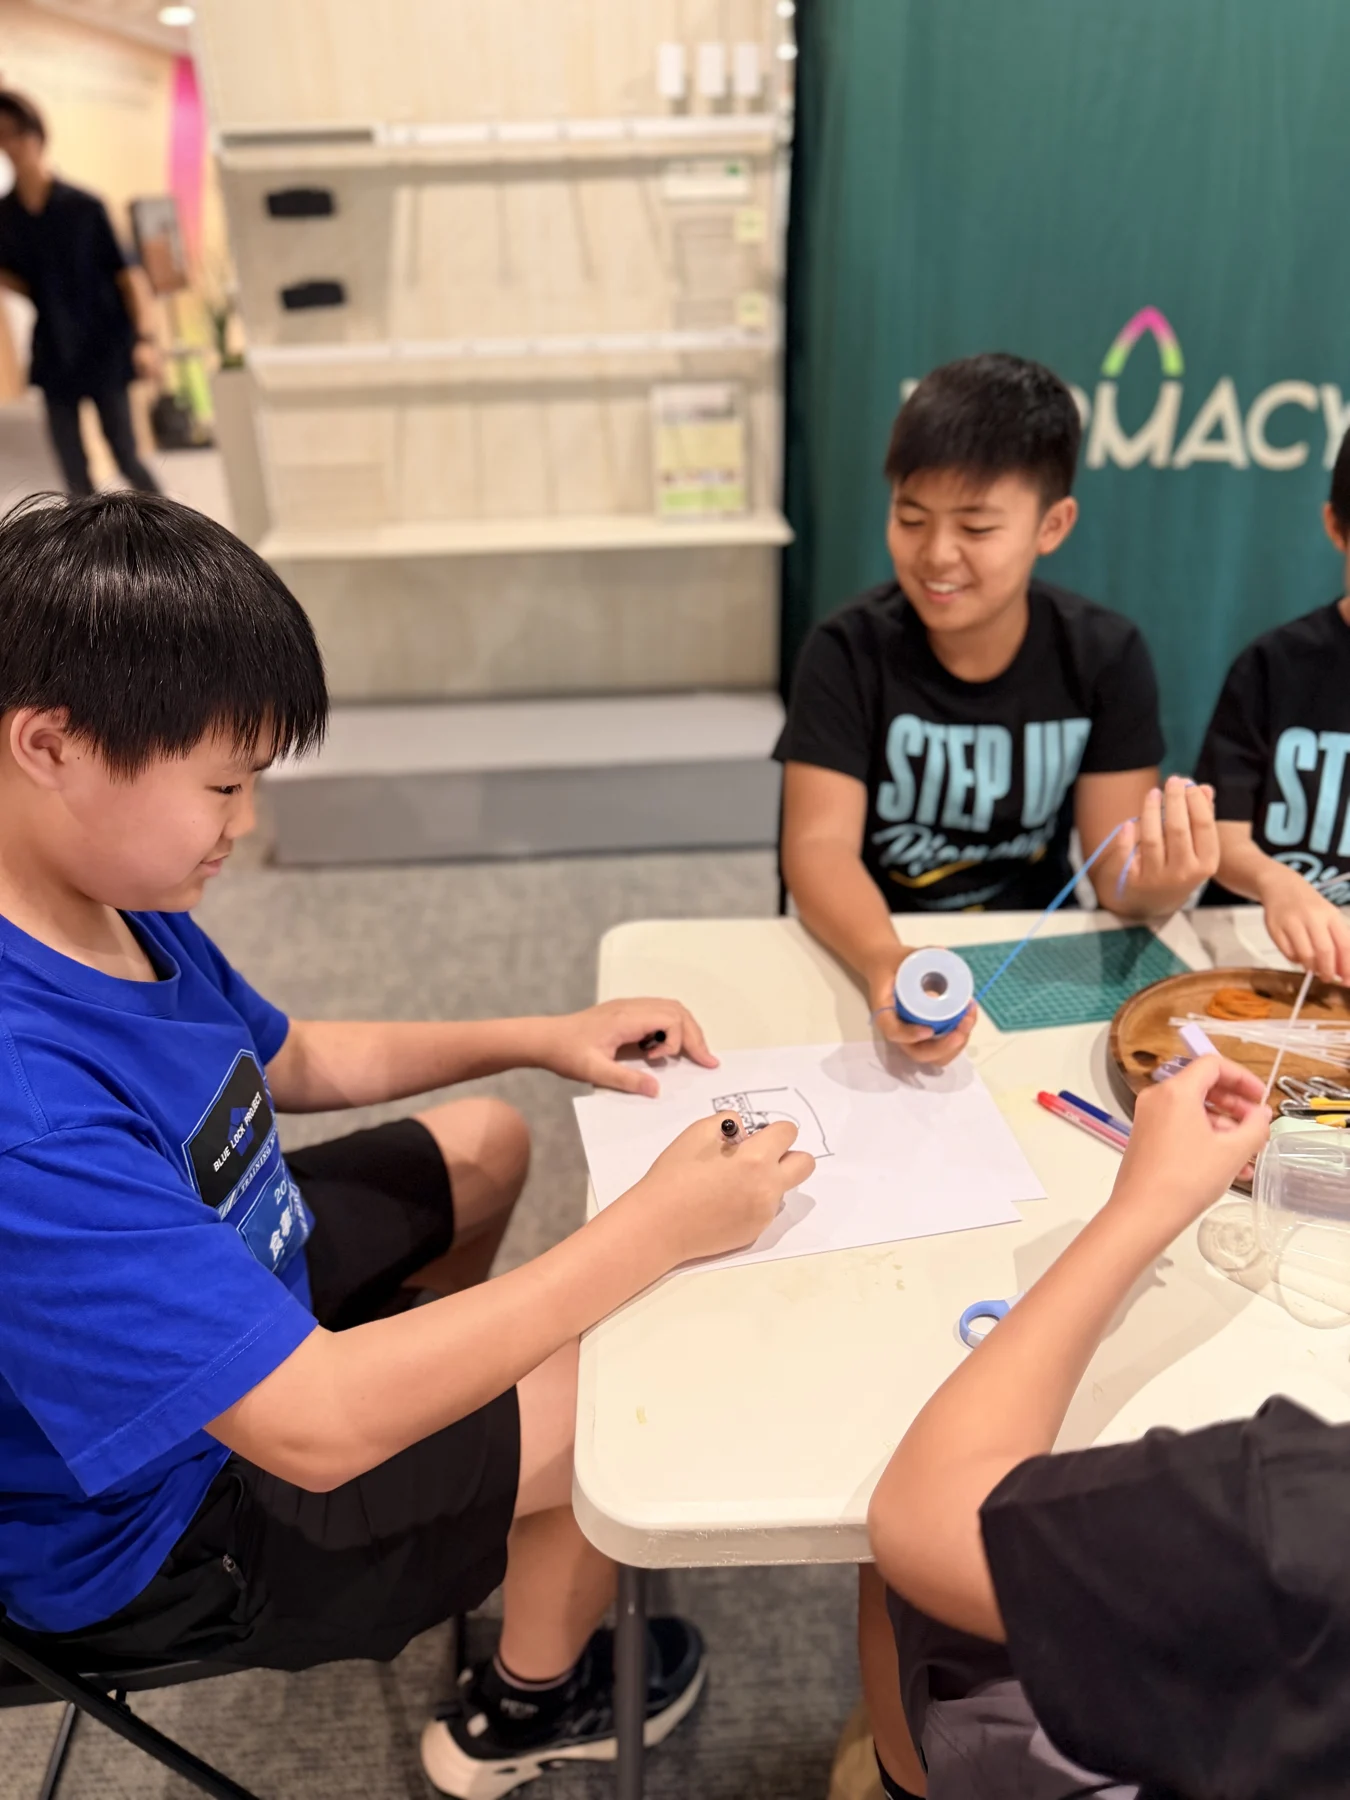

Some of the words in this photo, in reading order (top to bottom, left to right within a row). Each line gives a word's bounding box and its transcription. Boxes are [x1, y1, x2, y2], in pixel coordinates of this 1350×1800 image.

[899, 377, 1350, 470] MACY
[877, 714, 1013, 832] STEP
[1264, 726, 1350, 857] ST
[213, 1146, 231, 1172] BLUE
[230, 1123, 246, 1149] LOCK
[244, 1091, 262, 1126] PROJECT
[241, 1145, 271, 1192] TRAINING
